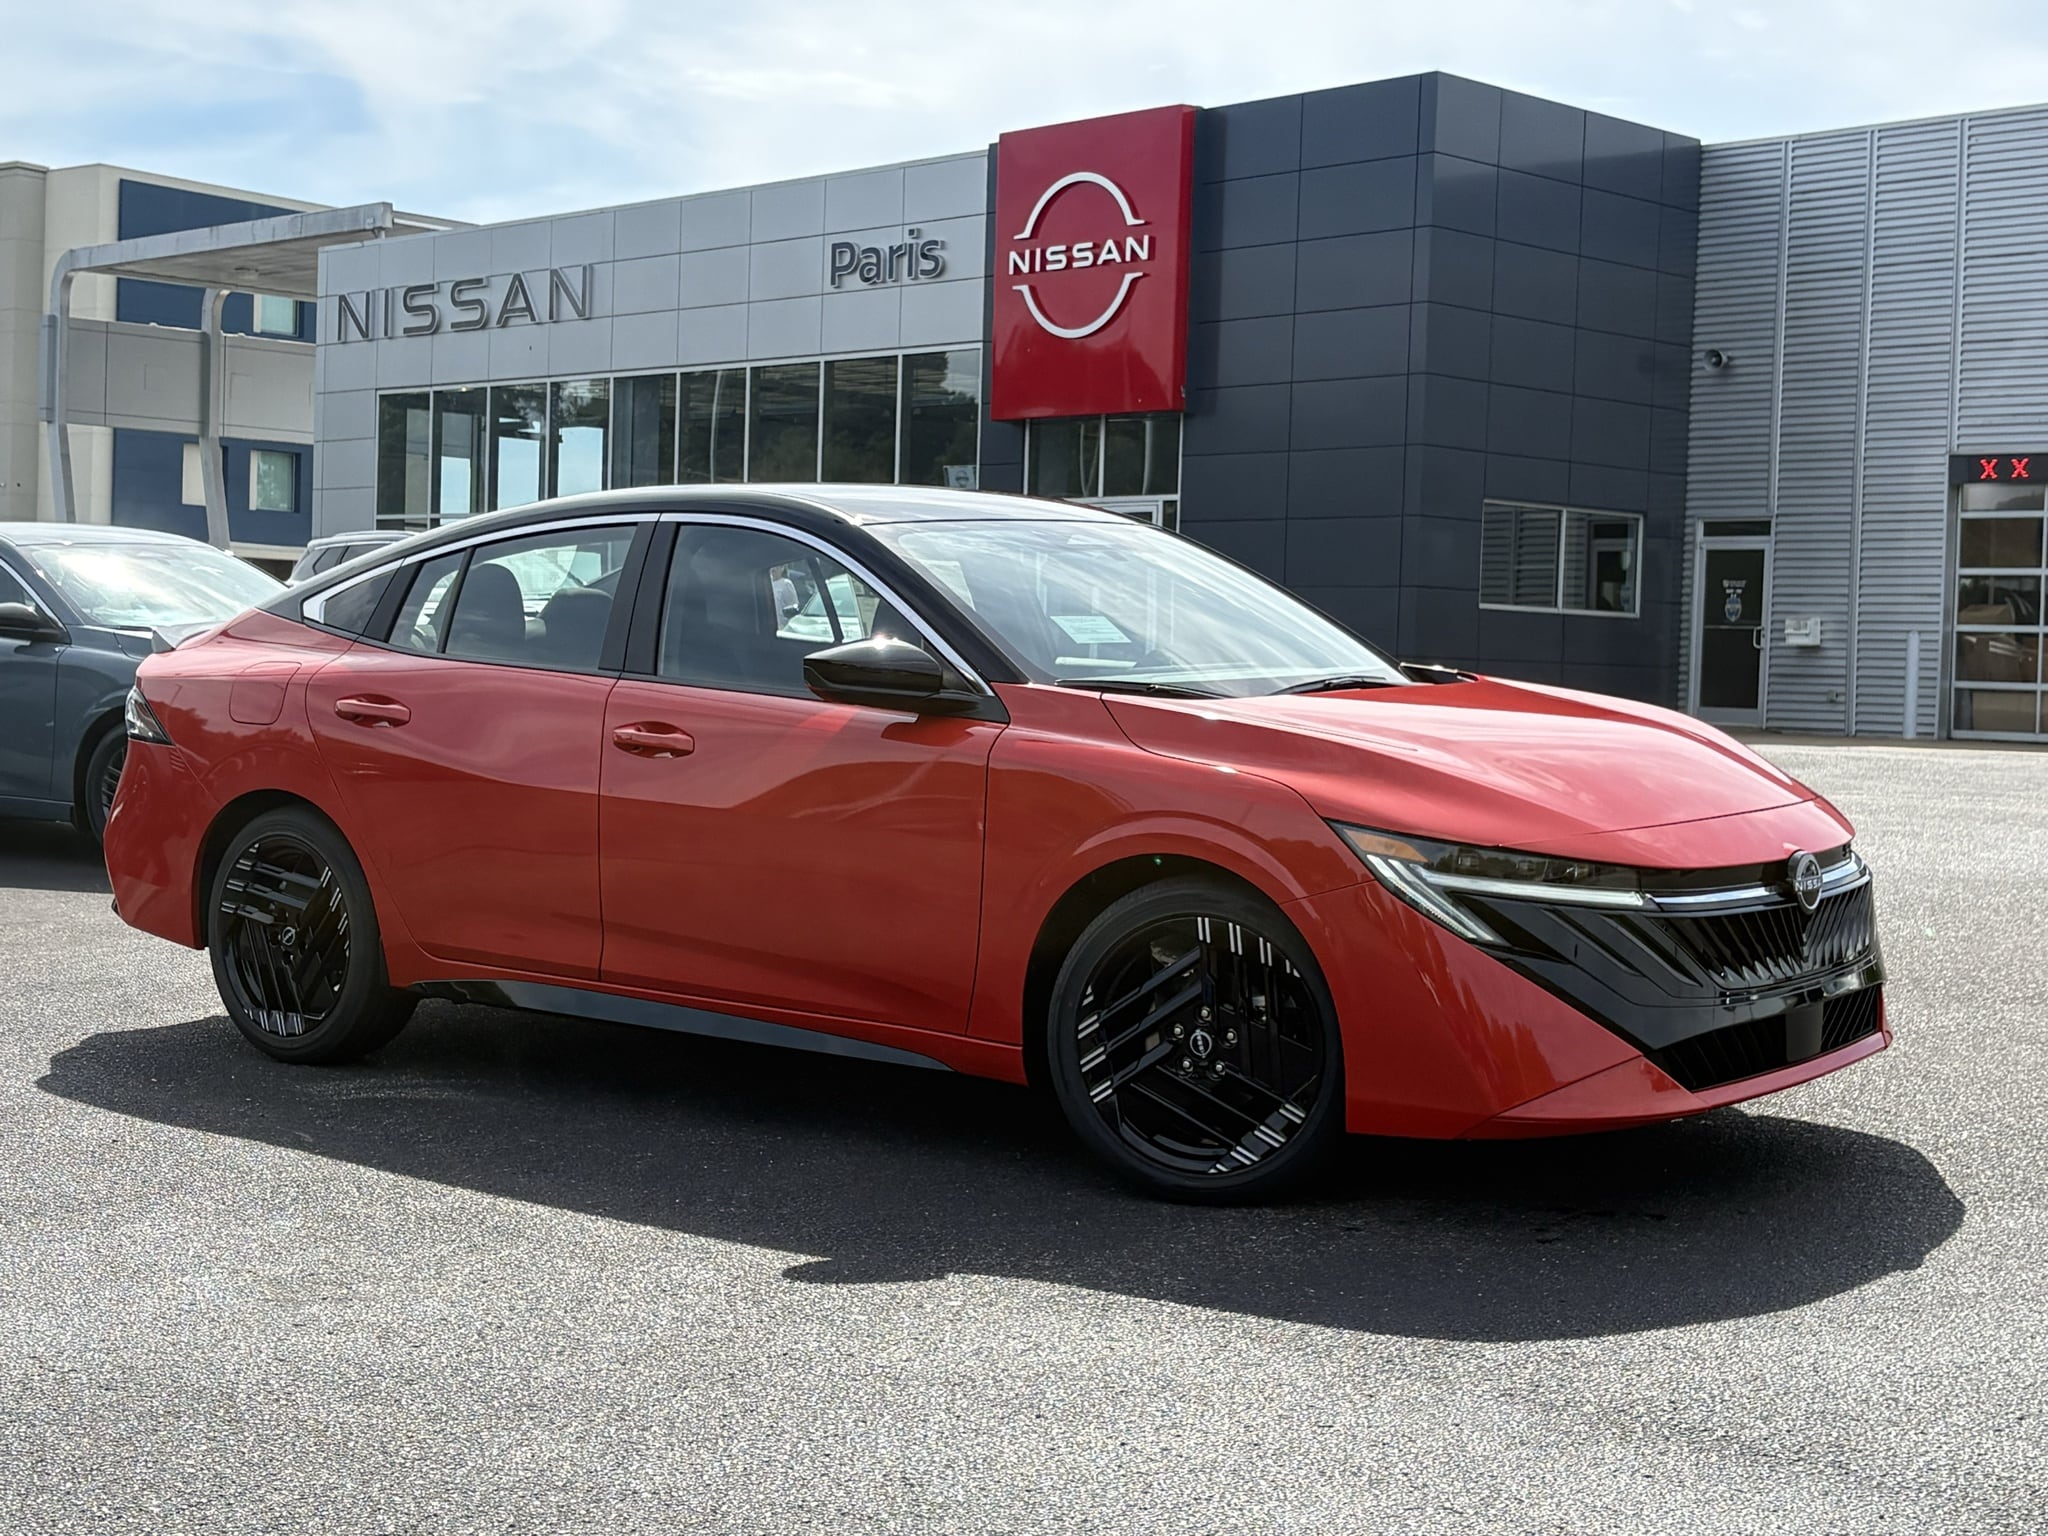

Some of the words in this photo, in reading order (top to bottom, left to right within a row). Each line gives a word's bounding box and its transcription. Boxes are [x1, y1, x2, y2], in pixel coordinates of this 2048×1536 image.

[830, 228, 944, 287] Paris
[1008, 234, 1149, 275] NISSAN
[336, 264, 590, 342] NISSAN
[1980, 458, 1998, 479] X
[2011, 457, 2030, 478] X
[1795, 878, 1821, 892] NISS
